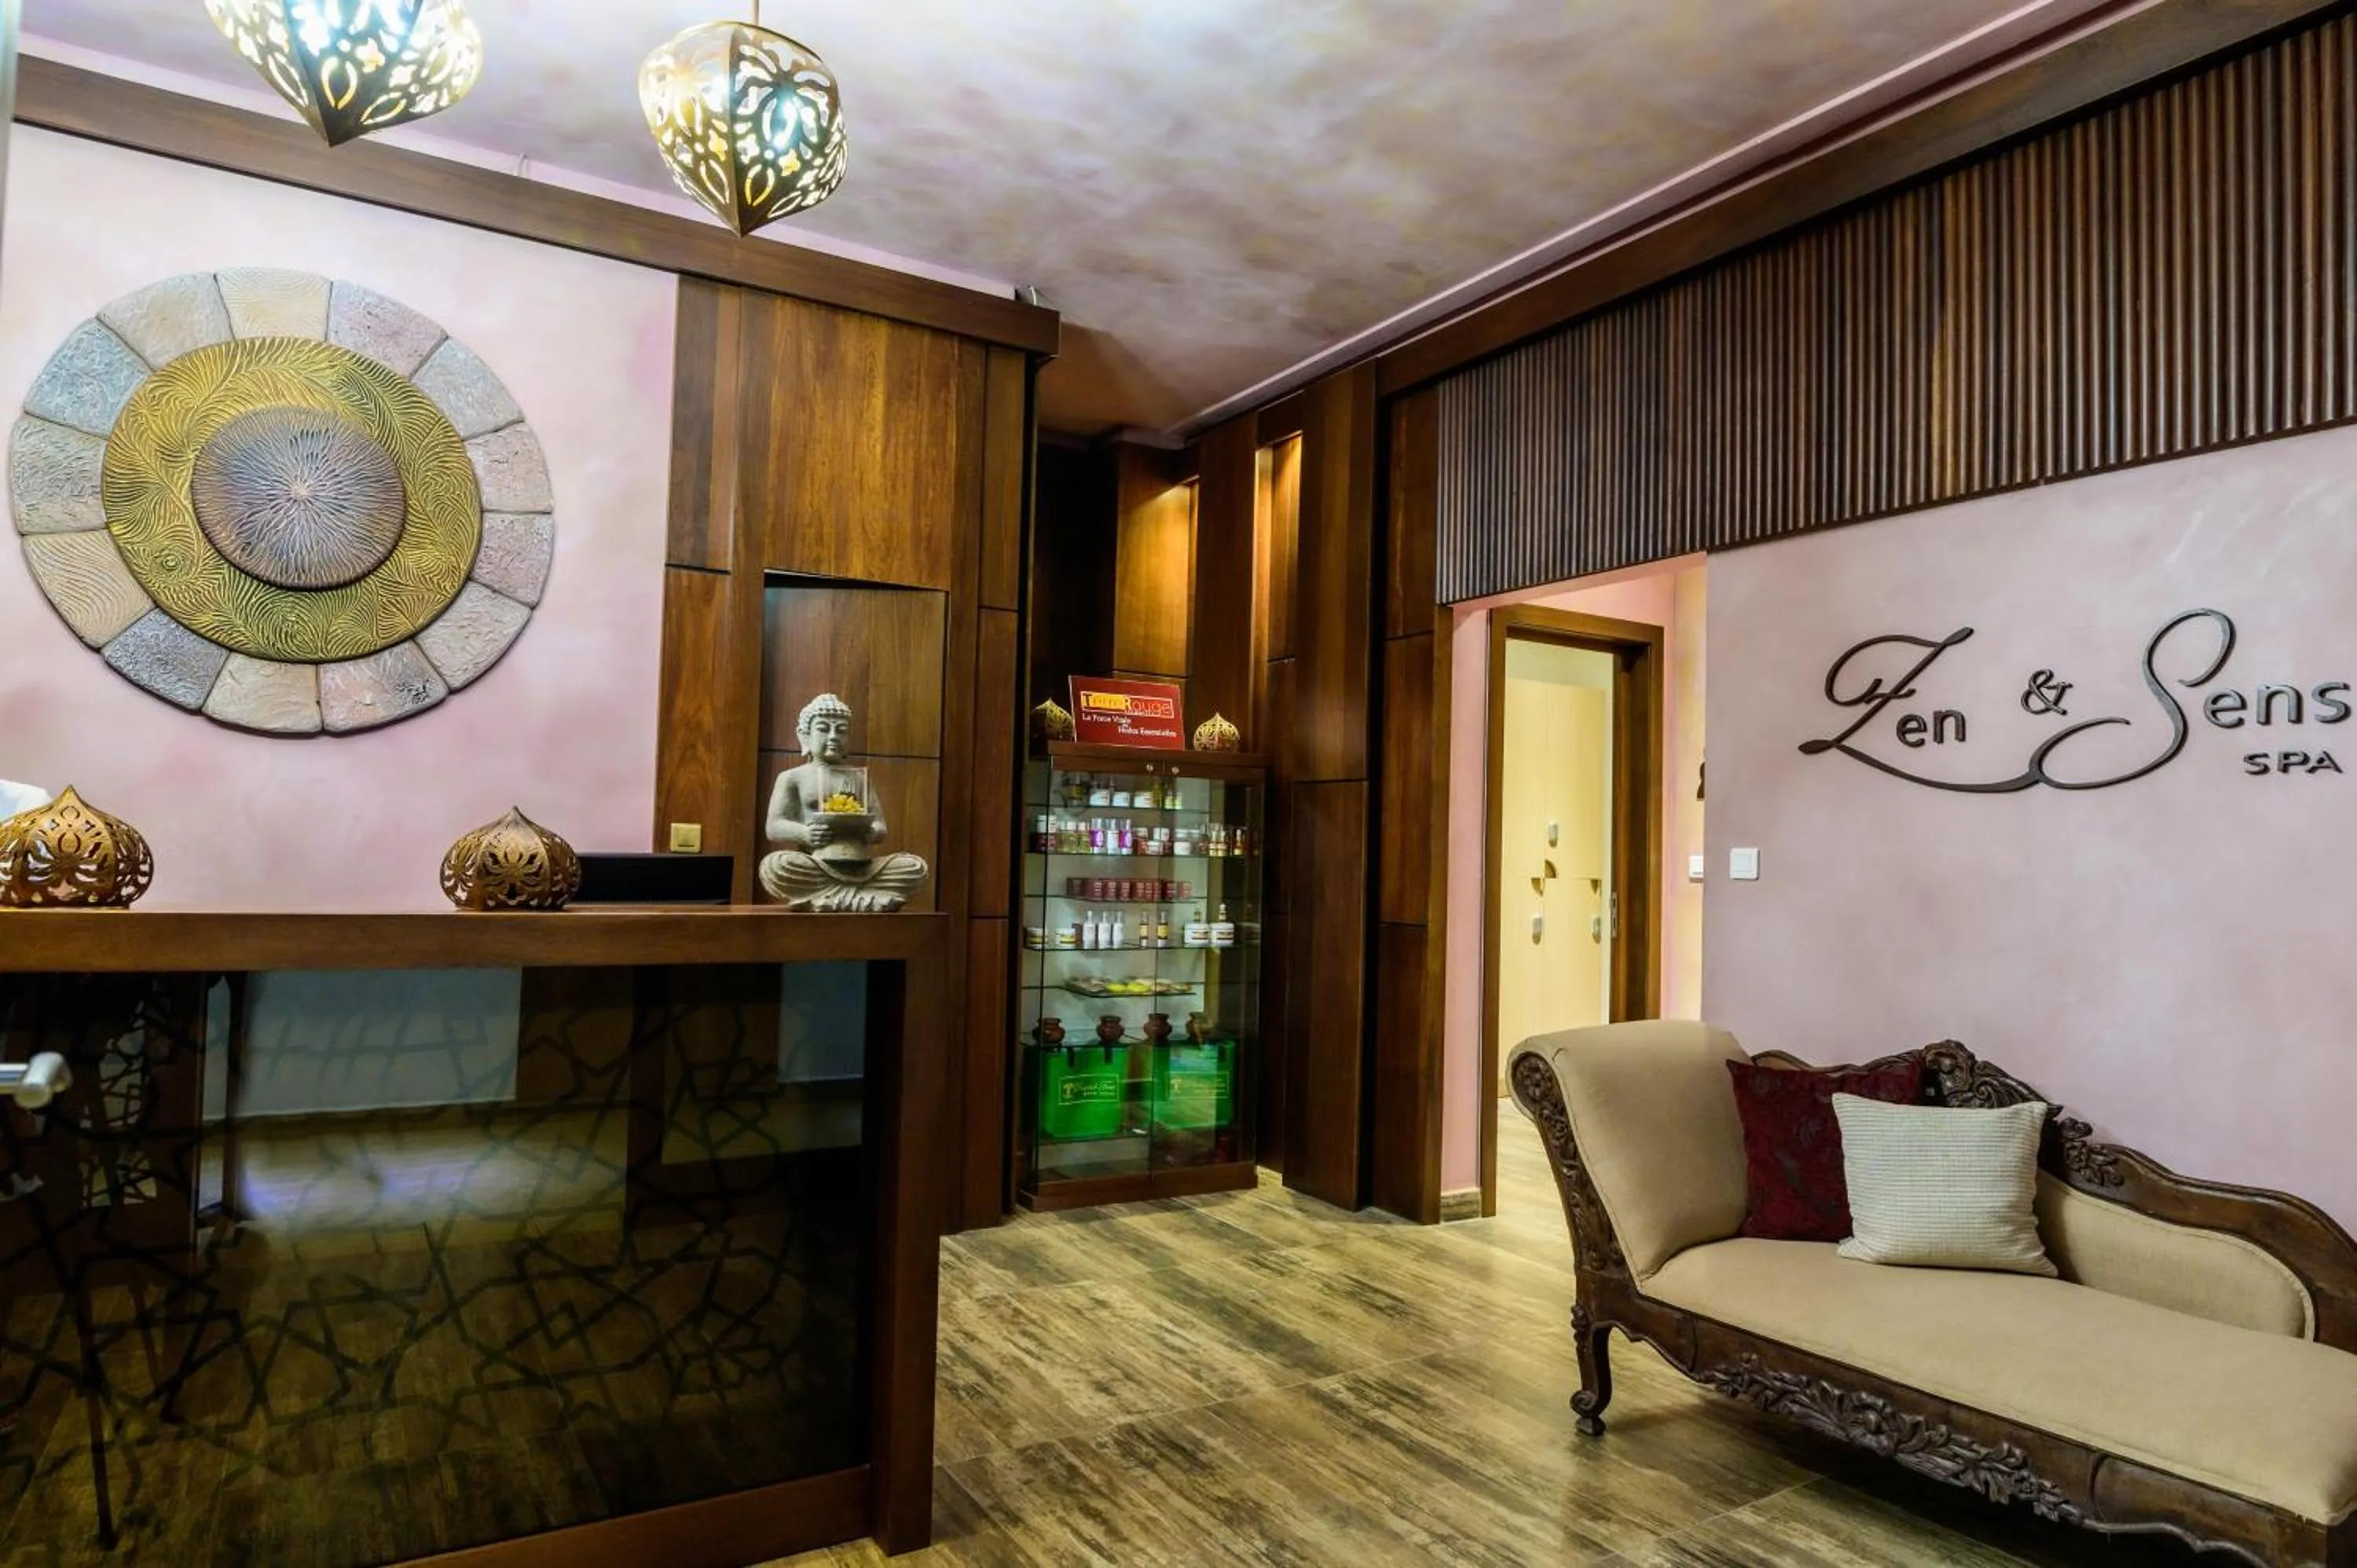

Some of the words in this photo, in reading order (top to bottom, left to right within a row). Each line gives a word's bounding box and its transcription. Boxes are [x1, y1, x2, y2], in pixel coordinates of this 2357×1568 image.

[1798, 626, 2036, 793] Zen
[2020, 669, 2073, 716] &
[2028, 607, 2353, 791] Sens
[2242, 750, 2344, 775] SPA
